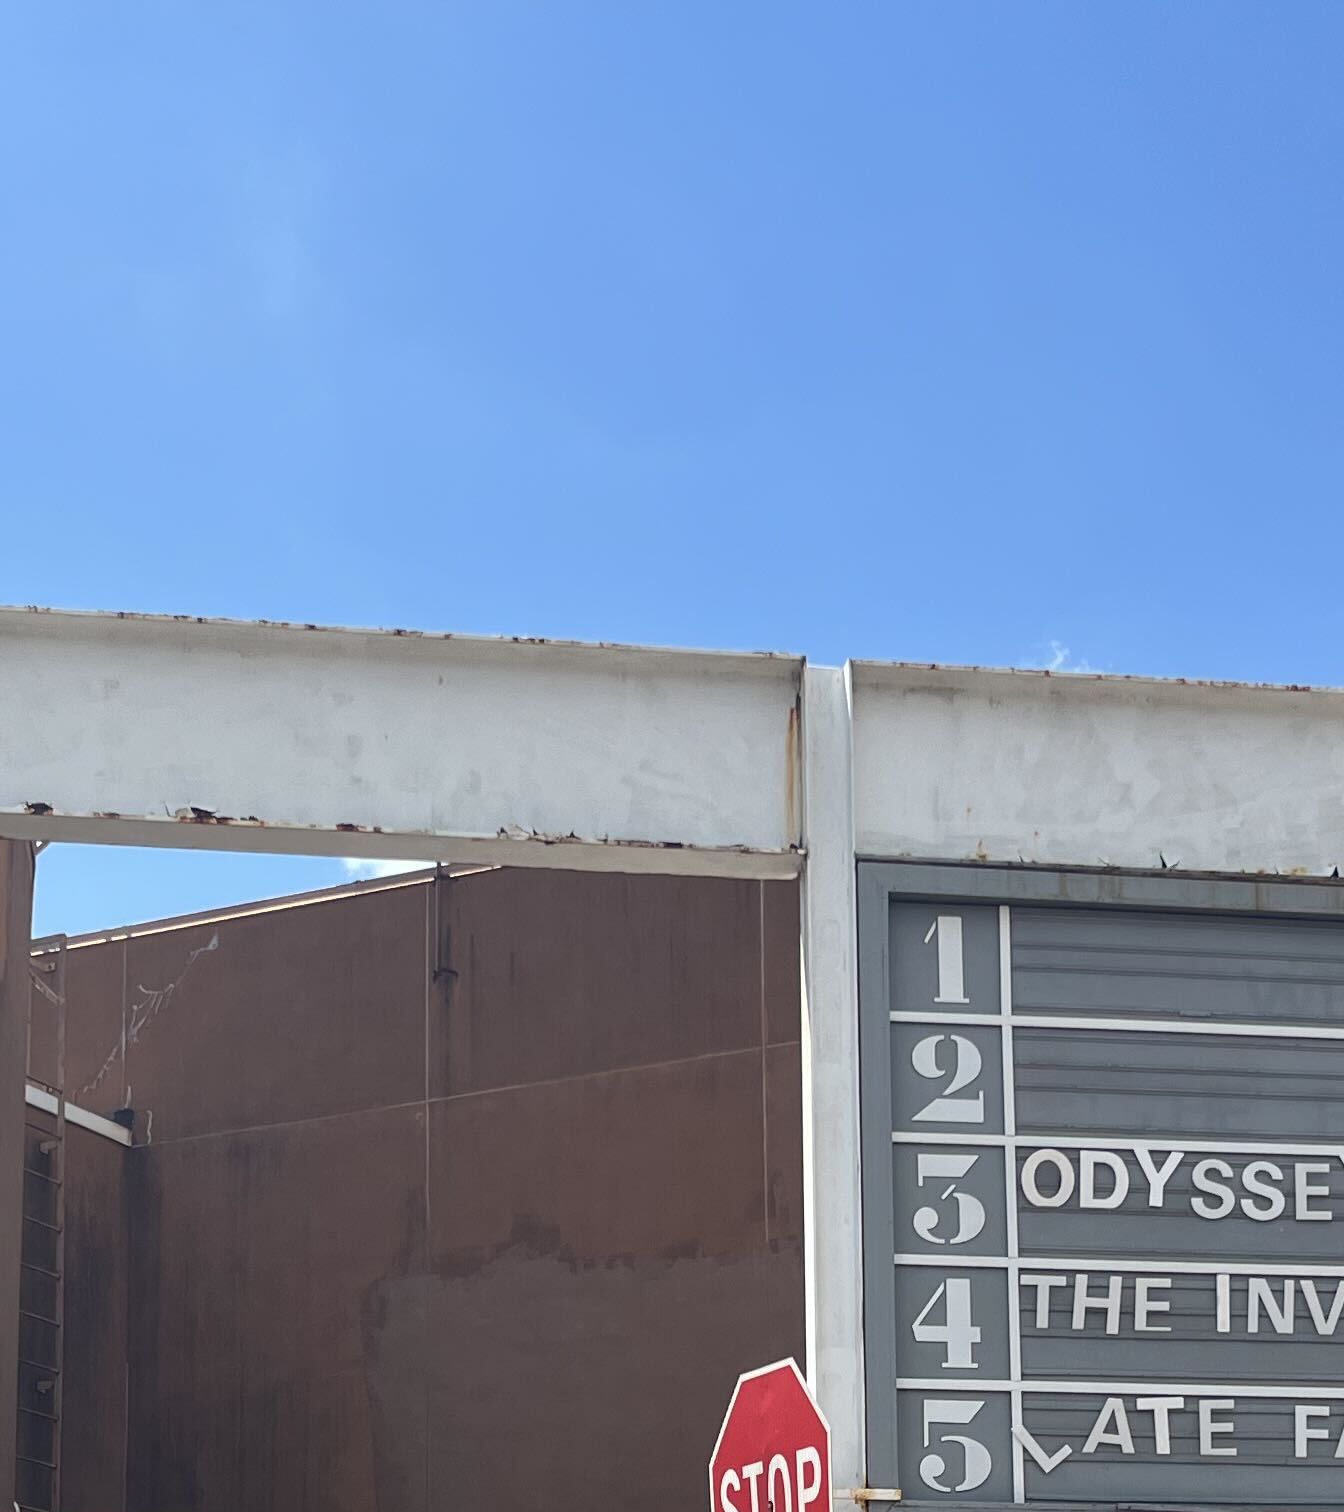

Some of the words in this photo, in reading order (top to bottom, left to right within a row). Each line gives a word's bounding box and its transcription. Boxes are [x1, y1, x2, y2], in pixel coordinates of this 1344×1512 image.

[923, 915, 970, 1004] 1
[911, 1034, 985, 1124] 2
[912, 1153, 987, 1245] 3
[911, 1277, 982, 1369] 4
[1019, 1273, 1173, 1335] THE
[918, 1398, 993, 1493] 5
